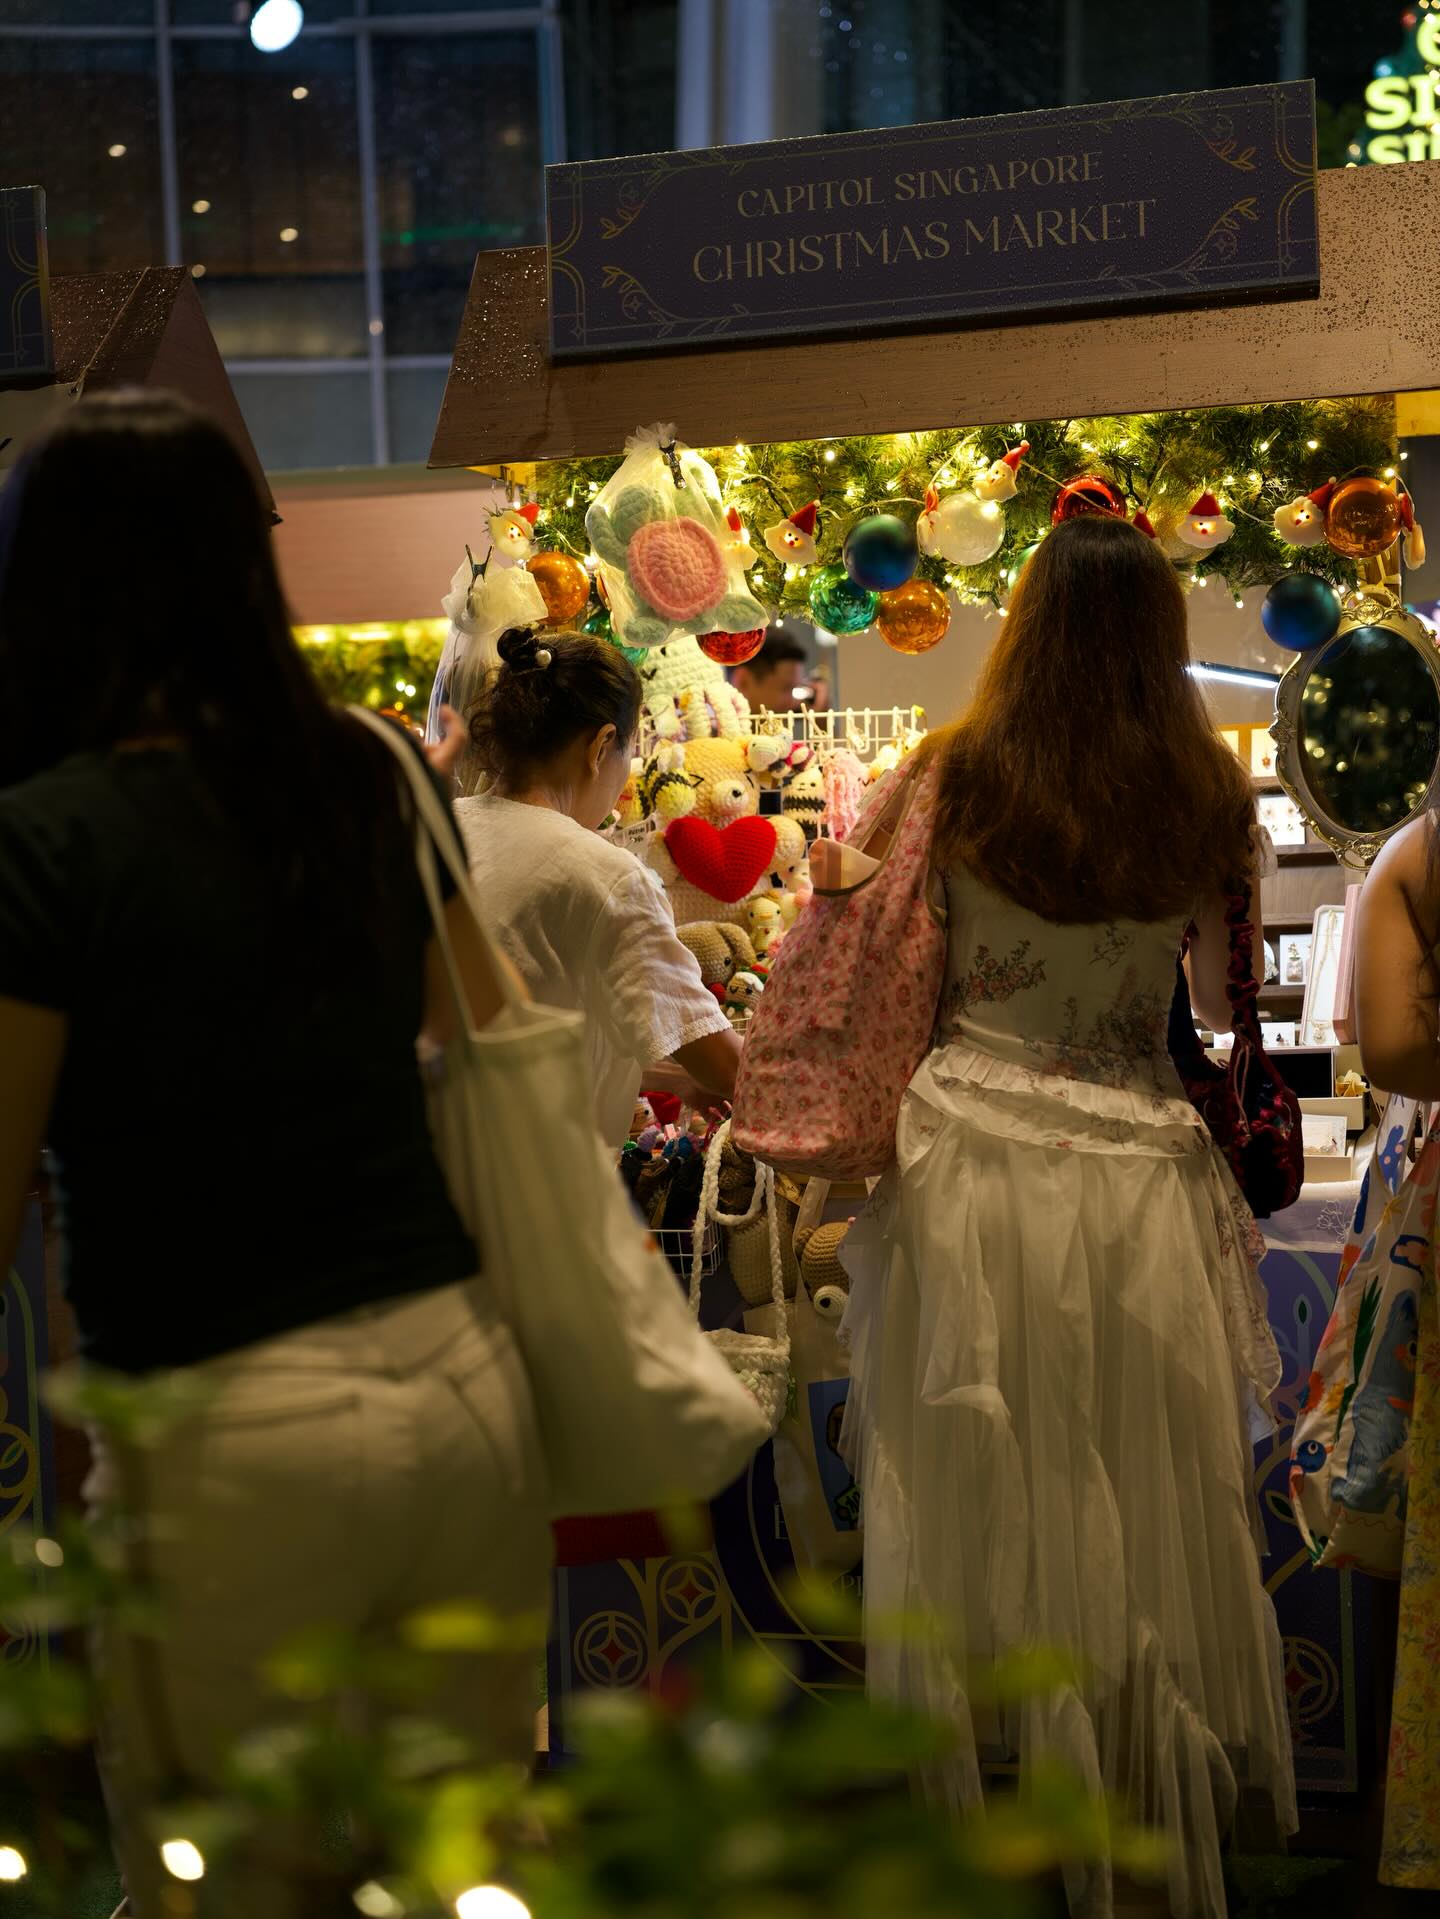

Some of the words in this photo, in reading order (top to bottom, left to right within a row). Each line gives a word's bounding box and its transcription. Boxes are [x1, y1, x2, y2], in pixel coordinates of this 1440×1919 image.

[738, 177, 884, 218] CAPITOL
[895, 152, 1101, 201] SINGAPORE
[693, 221, 950, 283] CHRISTMAS
[965, 199, 1157, 256] MARKET
